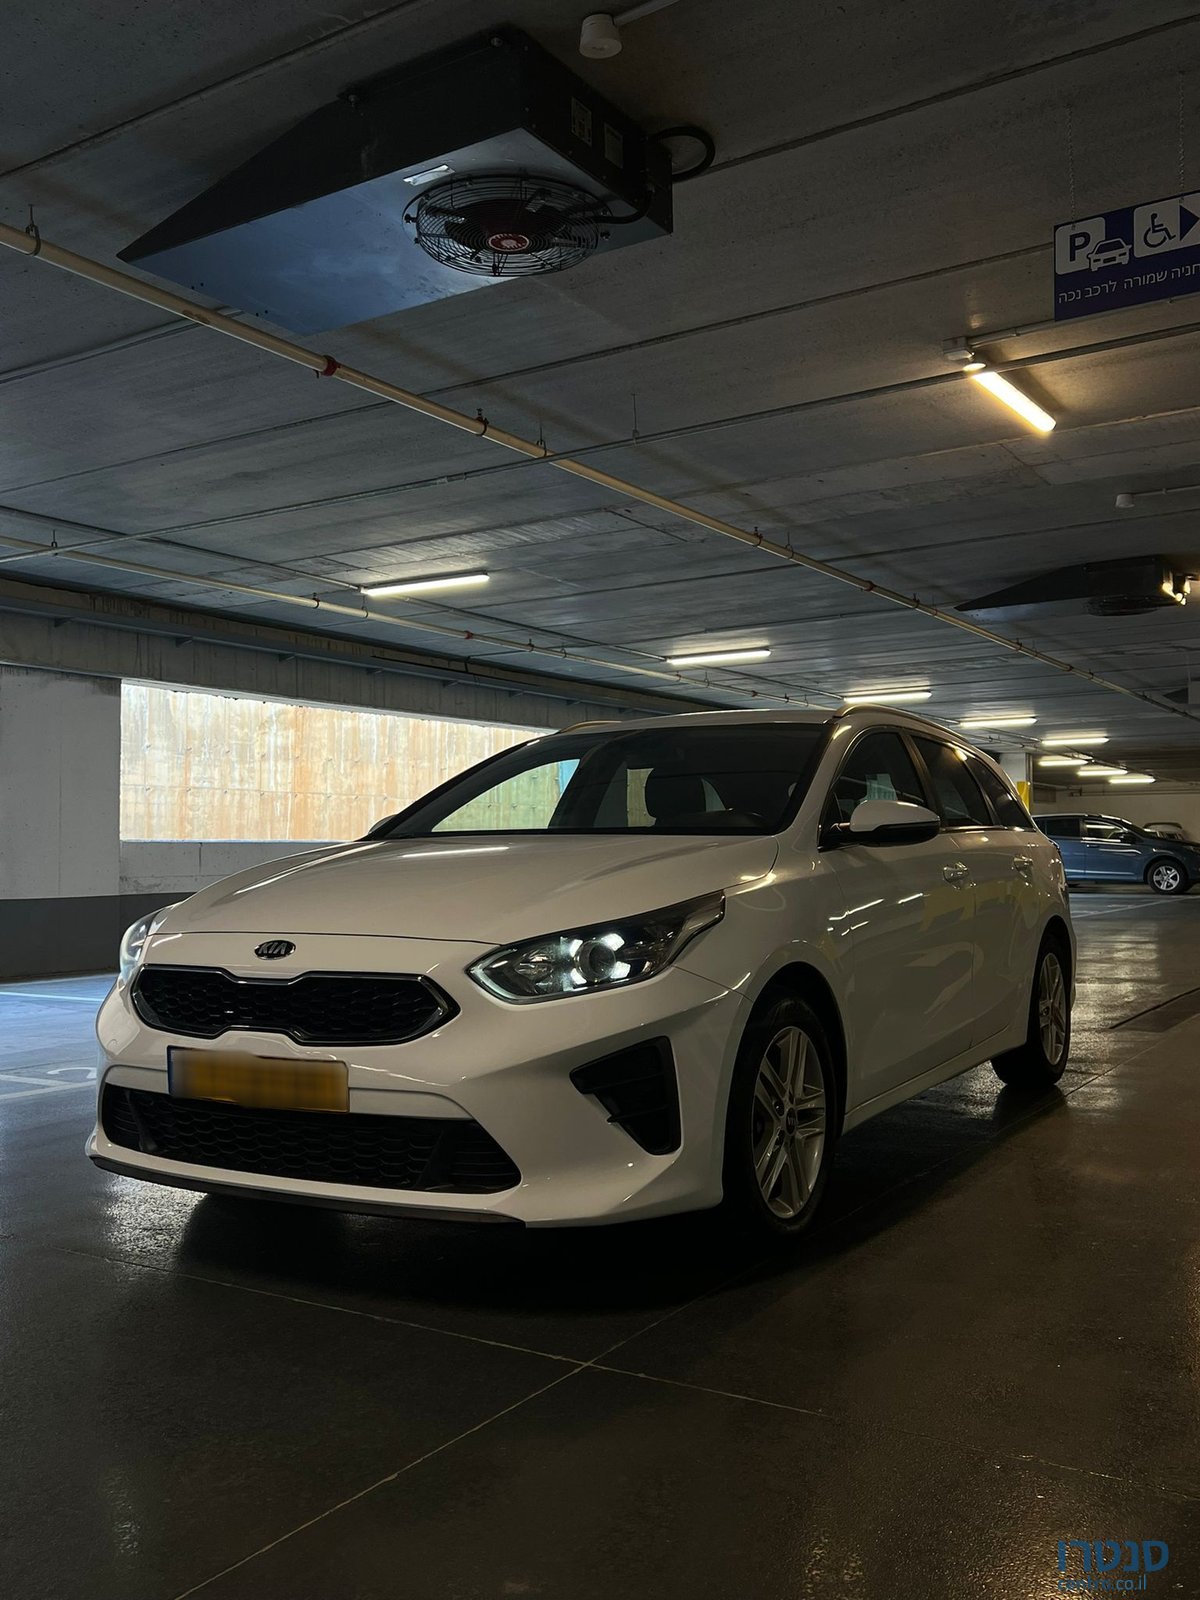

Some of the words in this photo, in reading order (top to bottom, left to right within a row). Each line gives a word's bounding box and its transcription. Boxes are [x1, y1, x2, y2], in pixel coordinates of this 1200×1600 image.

[1069, 231, 1091, 262] P
[1124, 270, 1168, 289] שמורה
[1058, 289, 1081, 304] נכה
[1084, 280, 1118, 298] לרכב
[257, 941, 288, 955] KIA
